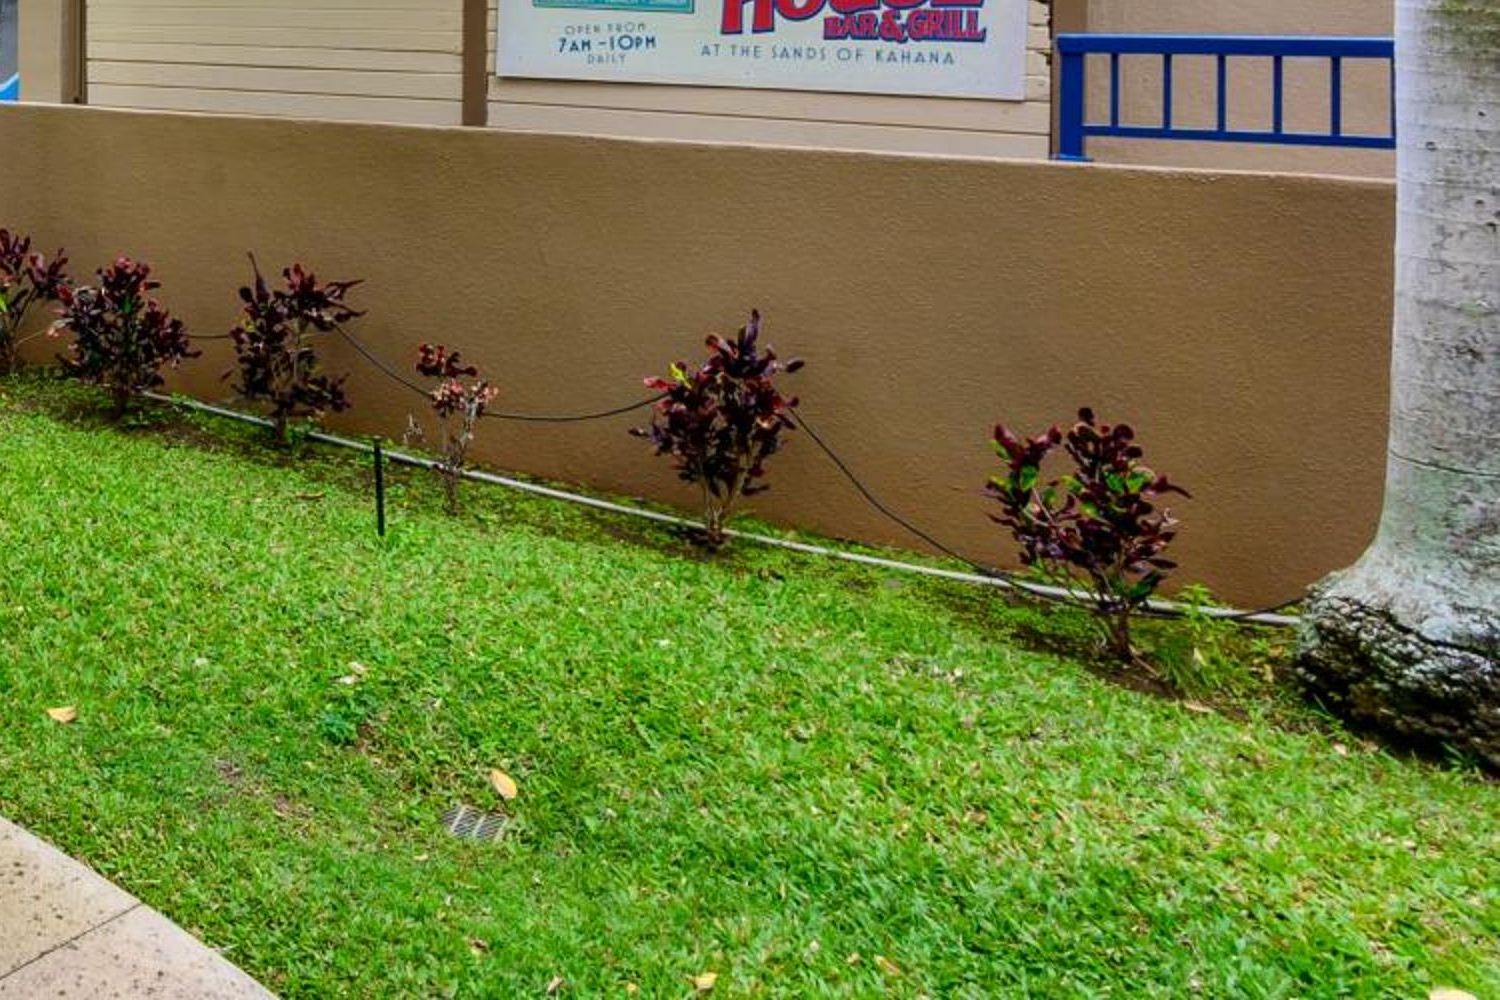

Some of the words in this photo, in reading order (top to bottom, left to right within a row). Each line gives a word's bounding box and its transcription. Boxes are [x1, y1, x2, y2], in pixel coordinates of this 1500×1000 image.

[564, 24, 601, 36] OPEN
[606, 21, 646, 34] FROM
[558, 37, 592, 53] 7AM
[587, 53, 627, 65] DAILY
[701, 43, 721, 57] AT
[729, 44, 762, 59] THE
[771, 45, 827, 62] SANDS
[837, 46, 864, 62] OF
[875, 47, 955, 65] KAHANA
